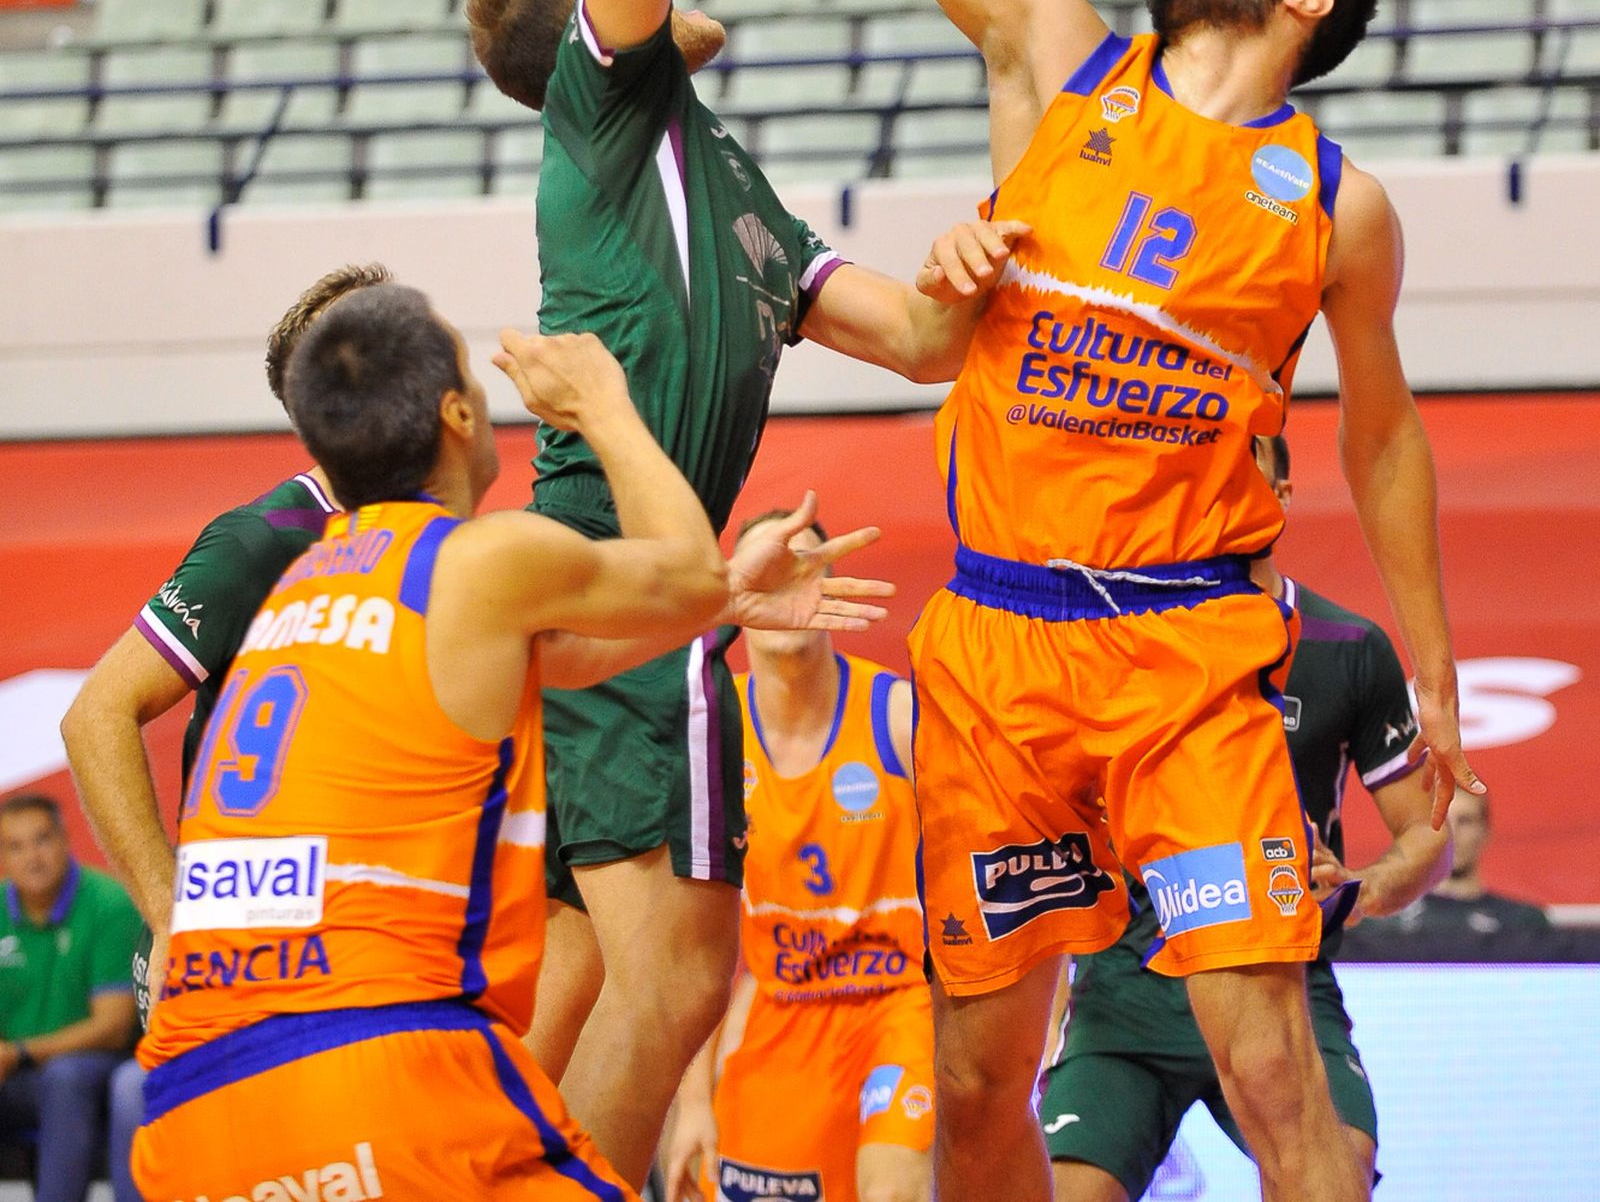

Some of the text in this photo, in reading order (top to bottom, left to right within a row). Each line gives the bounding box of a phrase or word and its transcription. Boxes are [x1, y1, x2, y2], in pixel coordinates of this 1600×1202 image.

[1079, 149, 1113, 167] luanvi
[1245, 191, 1300, 225] oneteam
[1098, 190, 1198, 290] 12
[1028, 310, 1233, 382] Cultura del
[1016, 352, 1230, 422] Esfuerzo
[1006, 403, 1223, 447] @ValenciaBasket
[181, 665, 310, 817] 19
[799, 842, 834, 896] 3
[1265, 846, 1289, 859] acb
[247, 907, 315, 922] pinturas
[1146, 873, 1247, 932] Midea
[721, 1164, 818, 1197] PULEVA
